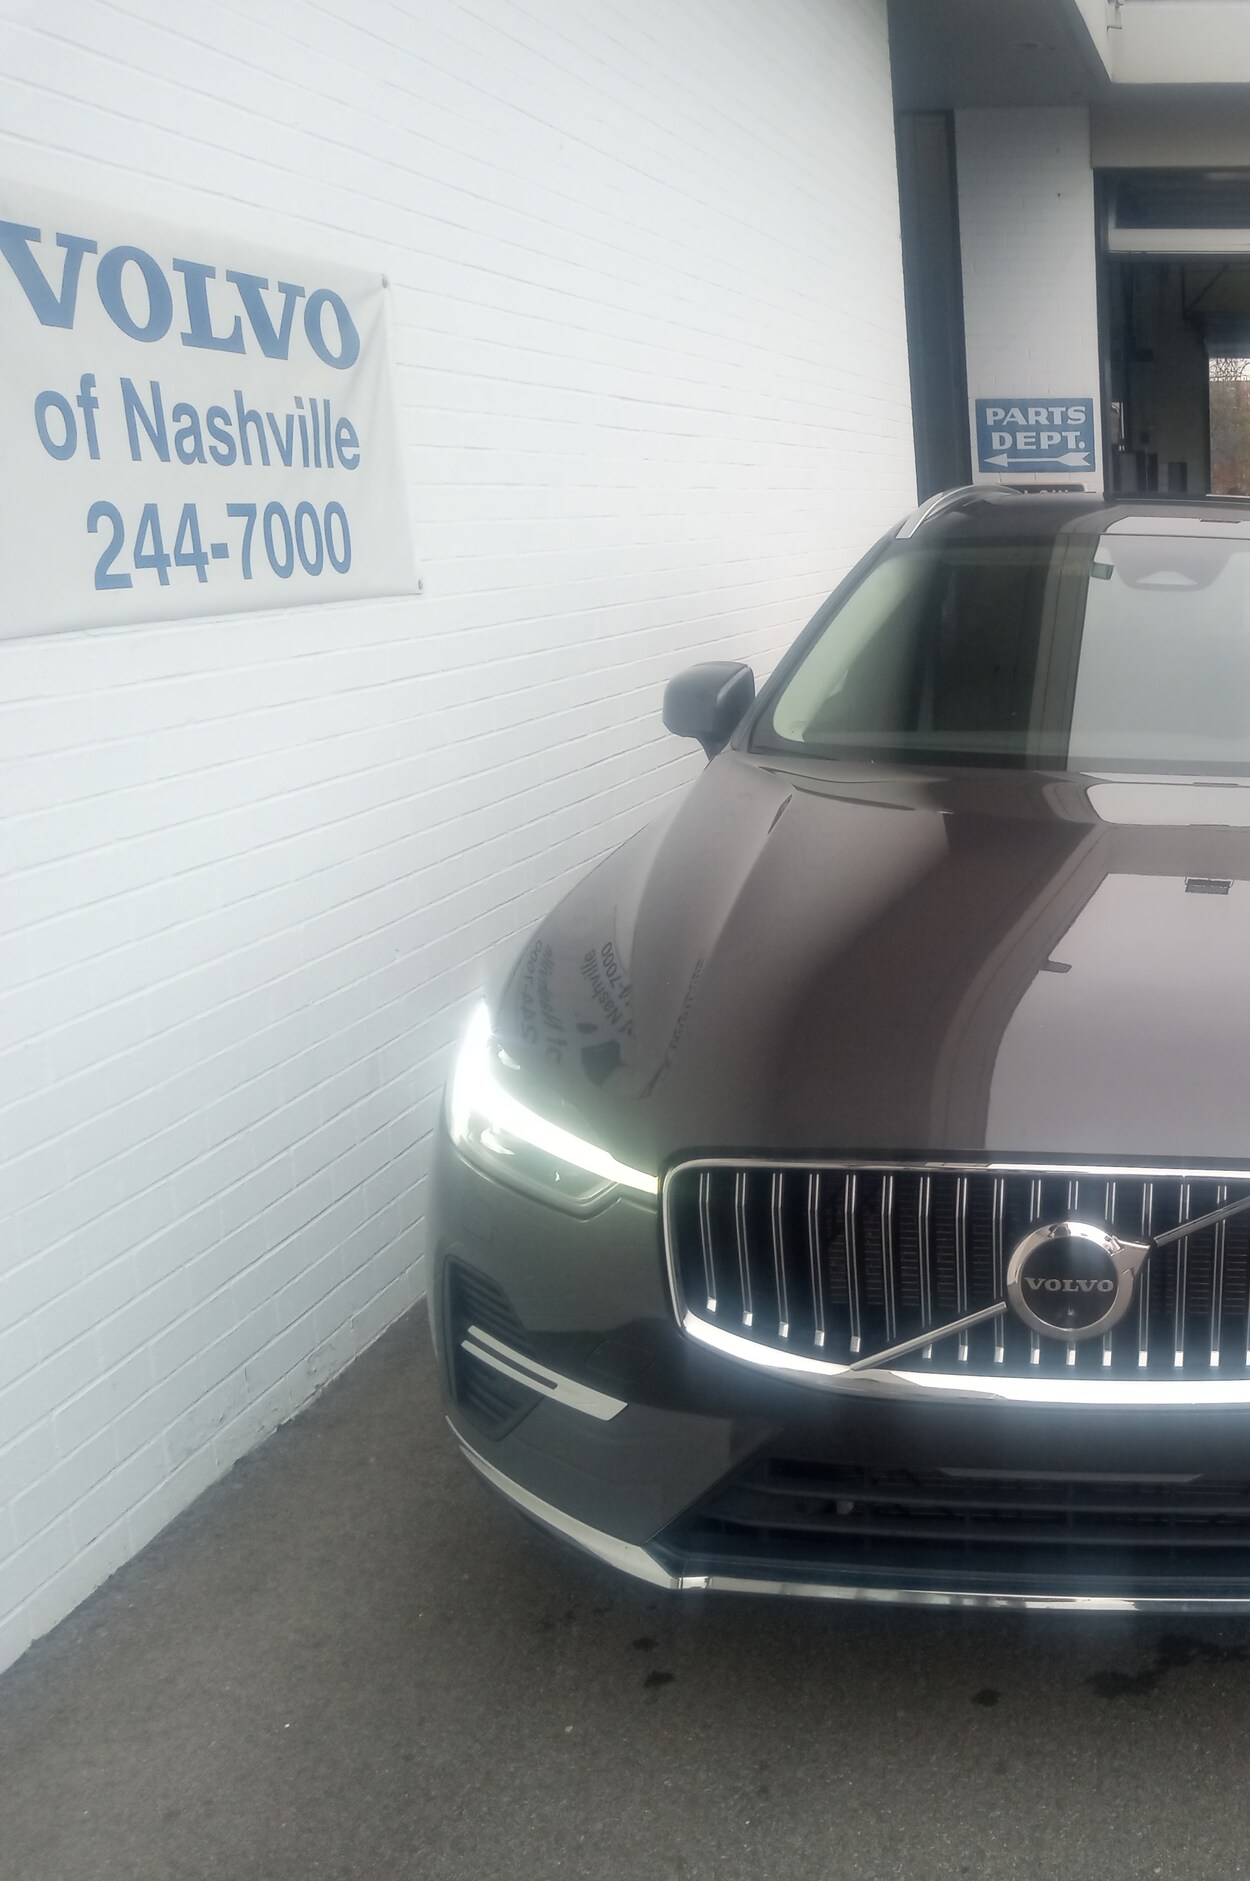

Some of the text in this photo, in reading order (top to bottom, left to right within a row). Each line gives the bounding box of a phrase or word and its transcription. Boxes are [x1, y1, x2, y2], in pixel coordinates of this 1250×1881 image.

[0, 220, 360, 370] VOLVO
[34, 373, 361, 470] of Nashville
[986, 406, 1087, 426] PARTS
[991, 431, 1086, 450] DEPT.
[87, 500, 352, 590] 244-7000
[1024, 1277, 1114, 1292] VOLVO
